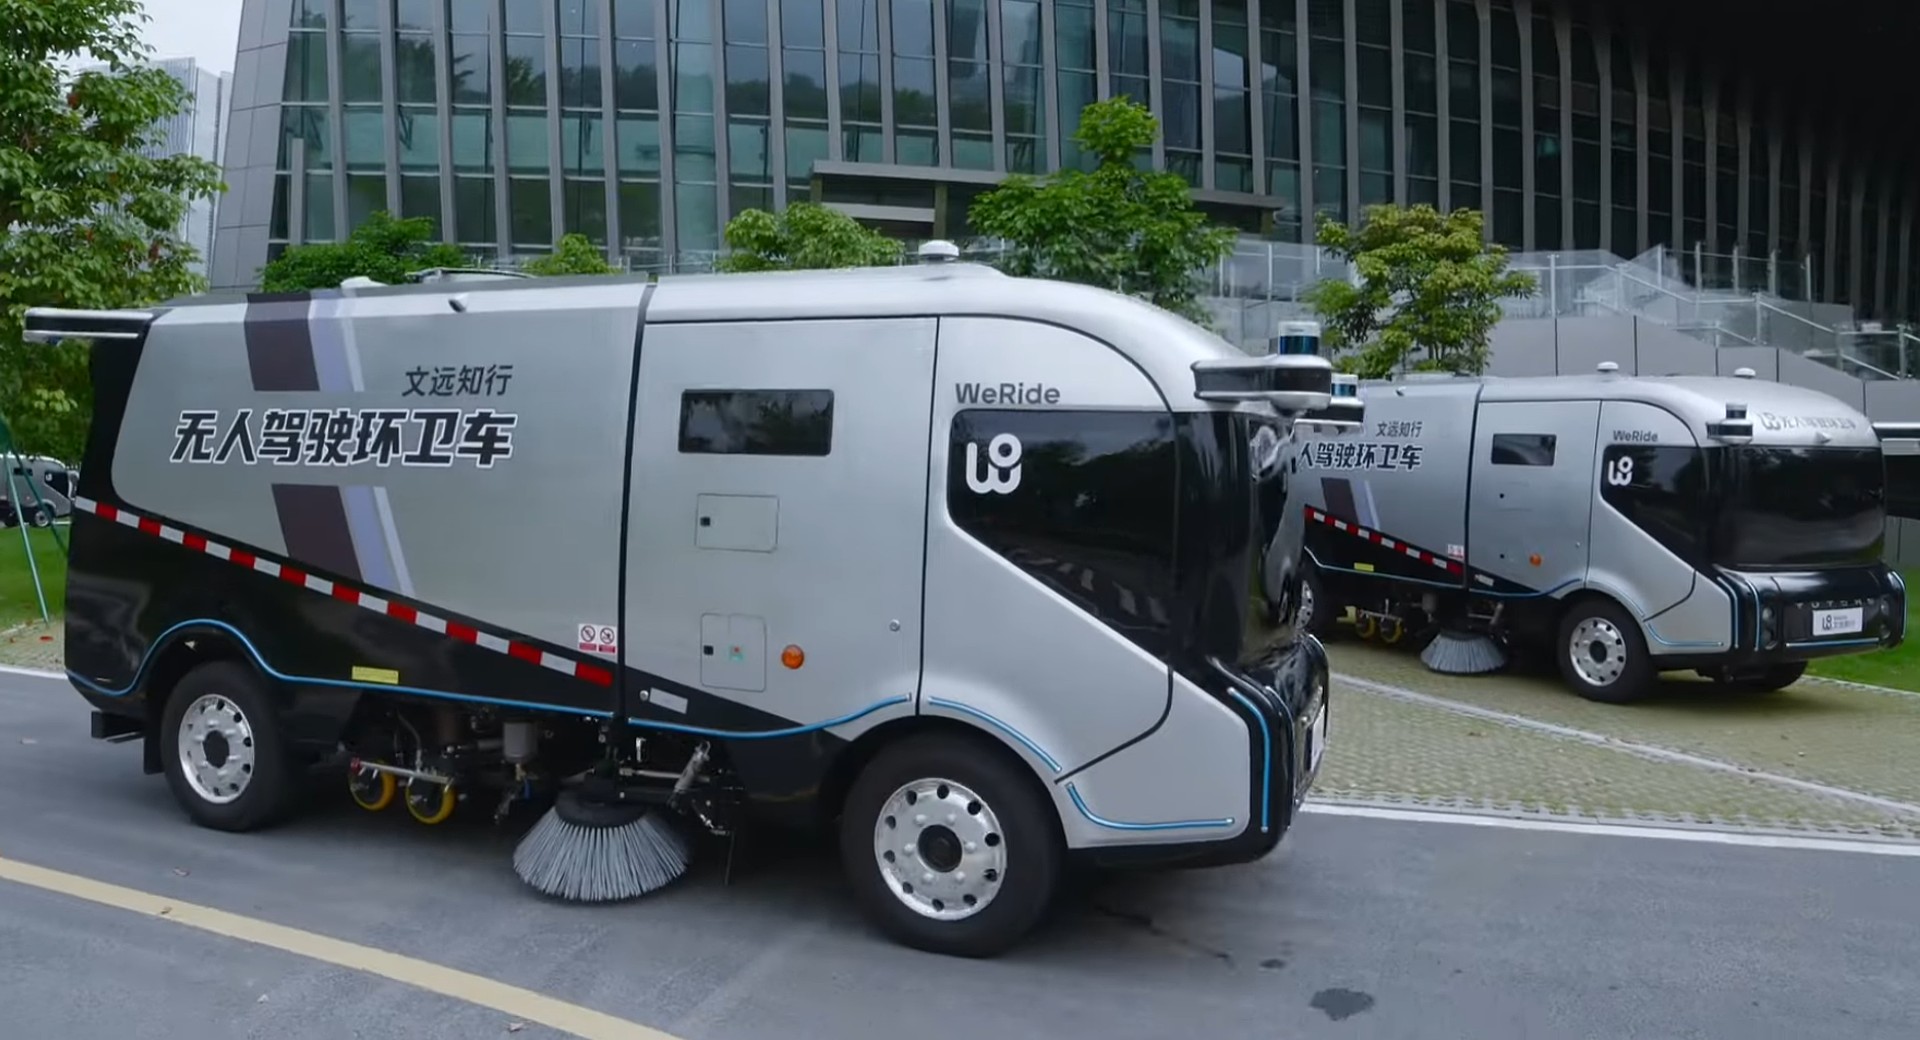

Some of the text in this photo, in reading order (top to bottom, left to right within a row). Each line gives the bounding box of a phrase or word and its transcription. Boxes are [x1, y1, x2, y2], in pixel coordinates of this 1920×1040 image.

[402, 364, 513, 397] 文远知行
[955, 382, 1061, 404] WeRide
[170, 409, 518, 469] 无人驾驶环卫车
[1376, 421, 1423, 438] 文远知行
[1613, 430, 1658, 442] WeRide
